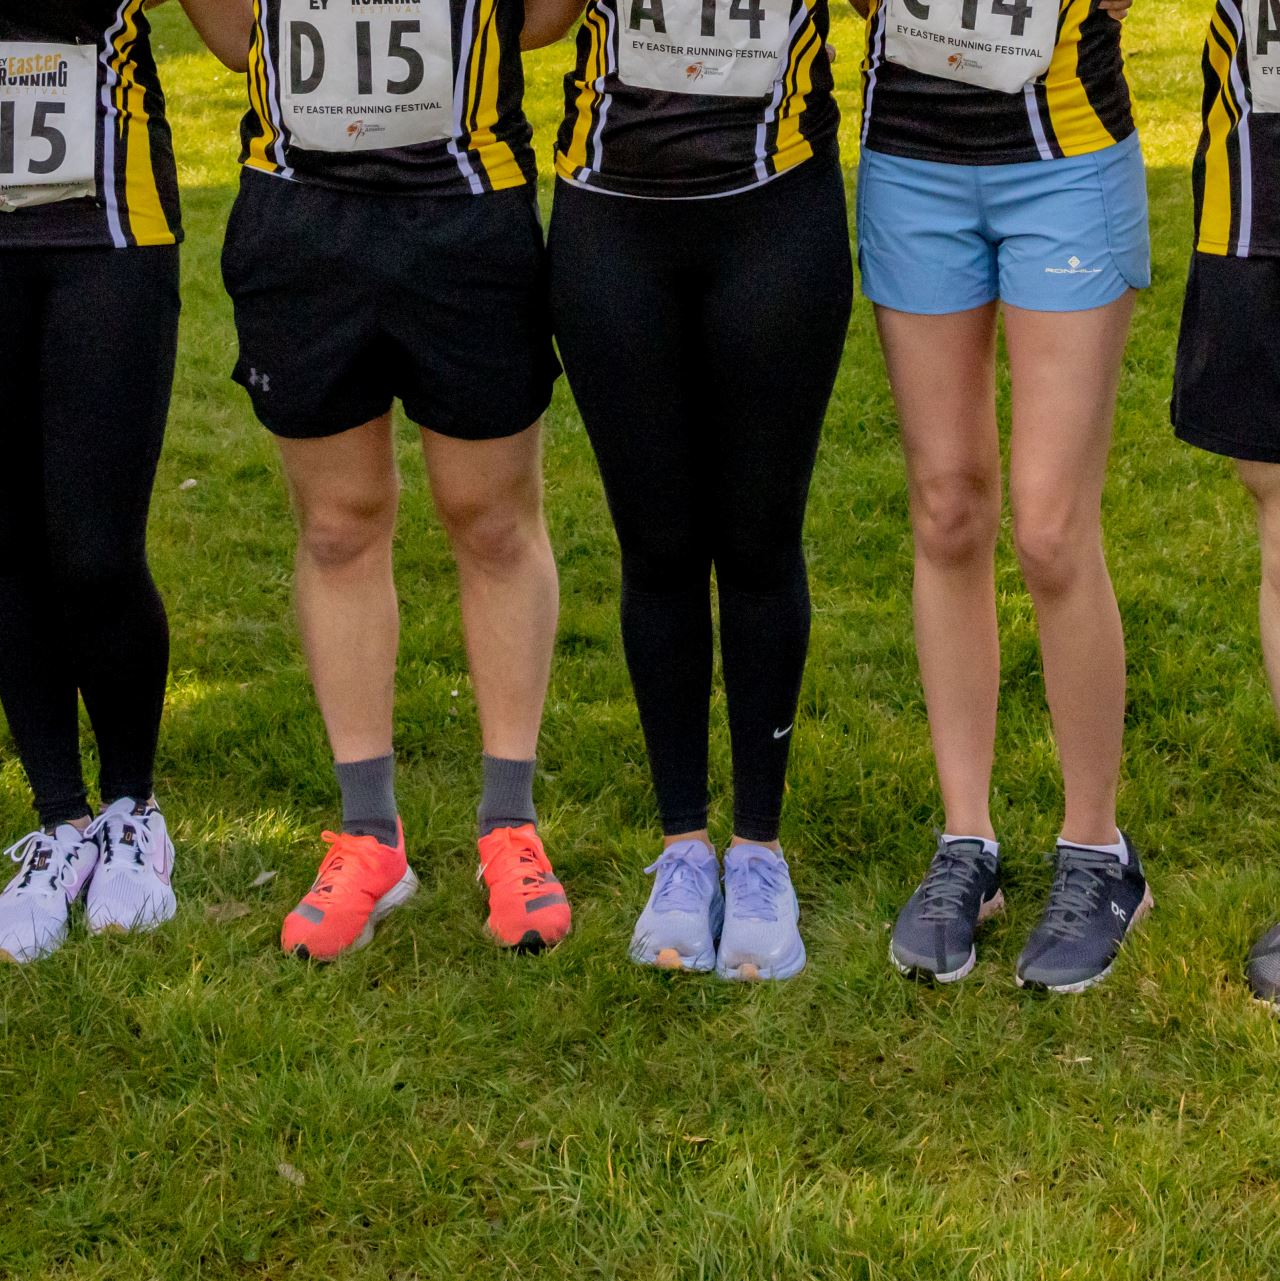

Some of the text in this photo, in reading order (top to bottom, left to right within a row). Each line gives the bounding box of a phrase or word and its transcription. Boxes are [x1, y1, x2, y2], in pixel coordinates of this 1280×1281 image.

[352, 5, 420, 14] FESTIVAL
[632, 40, 778, 59] EY EASTER RUNNING FESTIVAL
[896, 24, 1043, 59] EY EASTER RUNNING FESTIVAL
[8, 52, 63, 76] Easter
[290, 20, 325, 95] D
[355, 20, 425, 95] 15
[1262, 66, 1274, 75] EY
[293, 101, 442, 115] EY EASTER RUNNING FESTIVAL
[0, 100, 67, 175] 15
